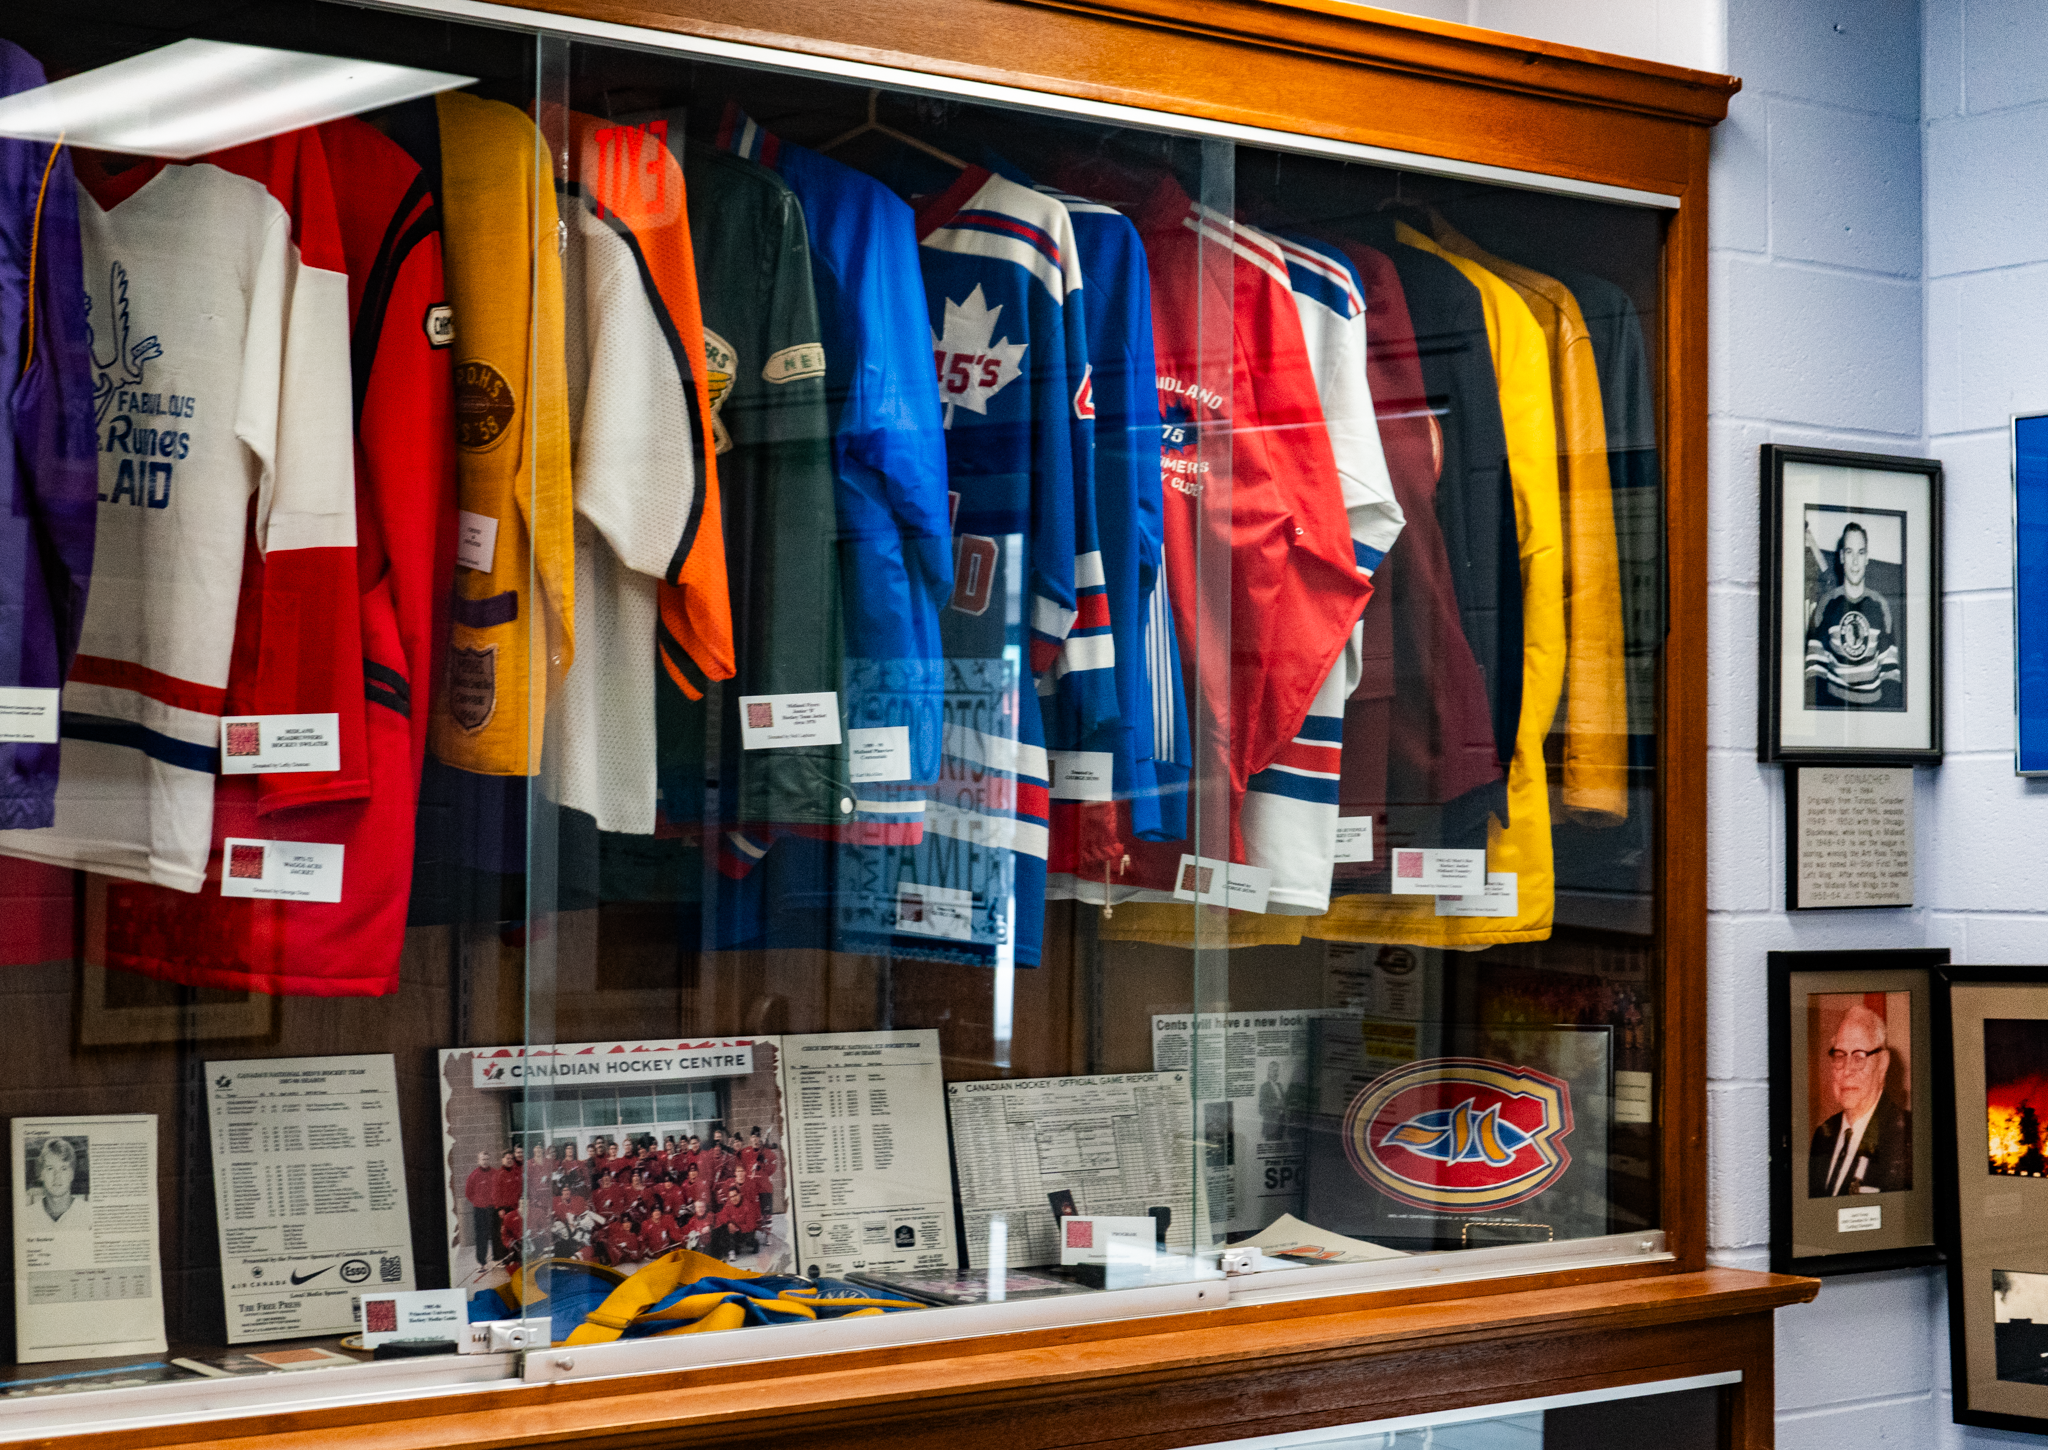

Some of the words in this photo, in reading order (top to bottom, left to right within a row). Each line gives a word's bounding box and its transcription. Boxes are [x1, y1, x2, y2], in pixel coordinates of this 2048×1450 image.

[1161, 424, 1186, 443] 75
[1156, 1019, 1188, 1031] Cents
[1191, 1018, 1212, 1030] will
[1215, 1017, 1240, 1029] have
[1243, 1019, 1250, 1028] a
[1254, 1018, 1276, 1027] new
[1280, 1015, 1303, 1026] look
[510, 1061, 601, 1078] CANADIAN
[606, 1058, 674, 1074] HOCKEY
[679, 1053, 746, 1070] CENTRE
[965, 1082, 1013, 1093] CANADIAN
[1015, 1080, 1050, 1091] HOCKEY
[1058, 1077, 1098, 1088] OFFICIAL
[1100, 1075, 1124, 1085] GAME
[1126, 1073, 1159, 1084] REPORT
[344, 1266, 367, 1277] Esso
[250, 1280, 287, 1288] CANADA
